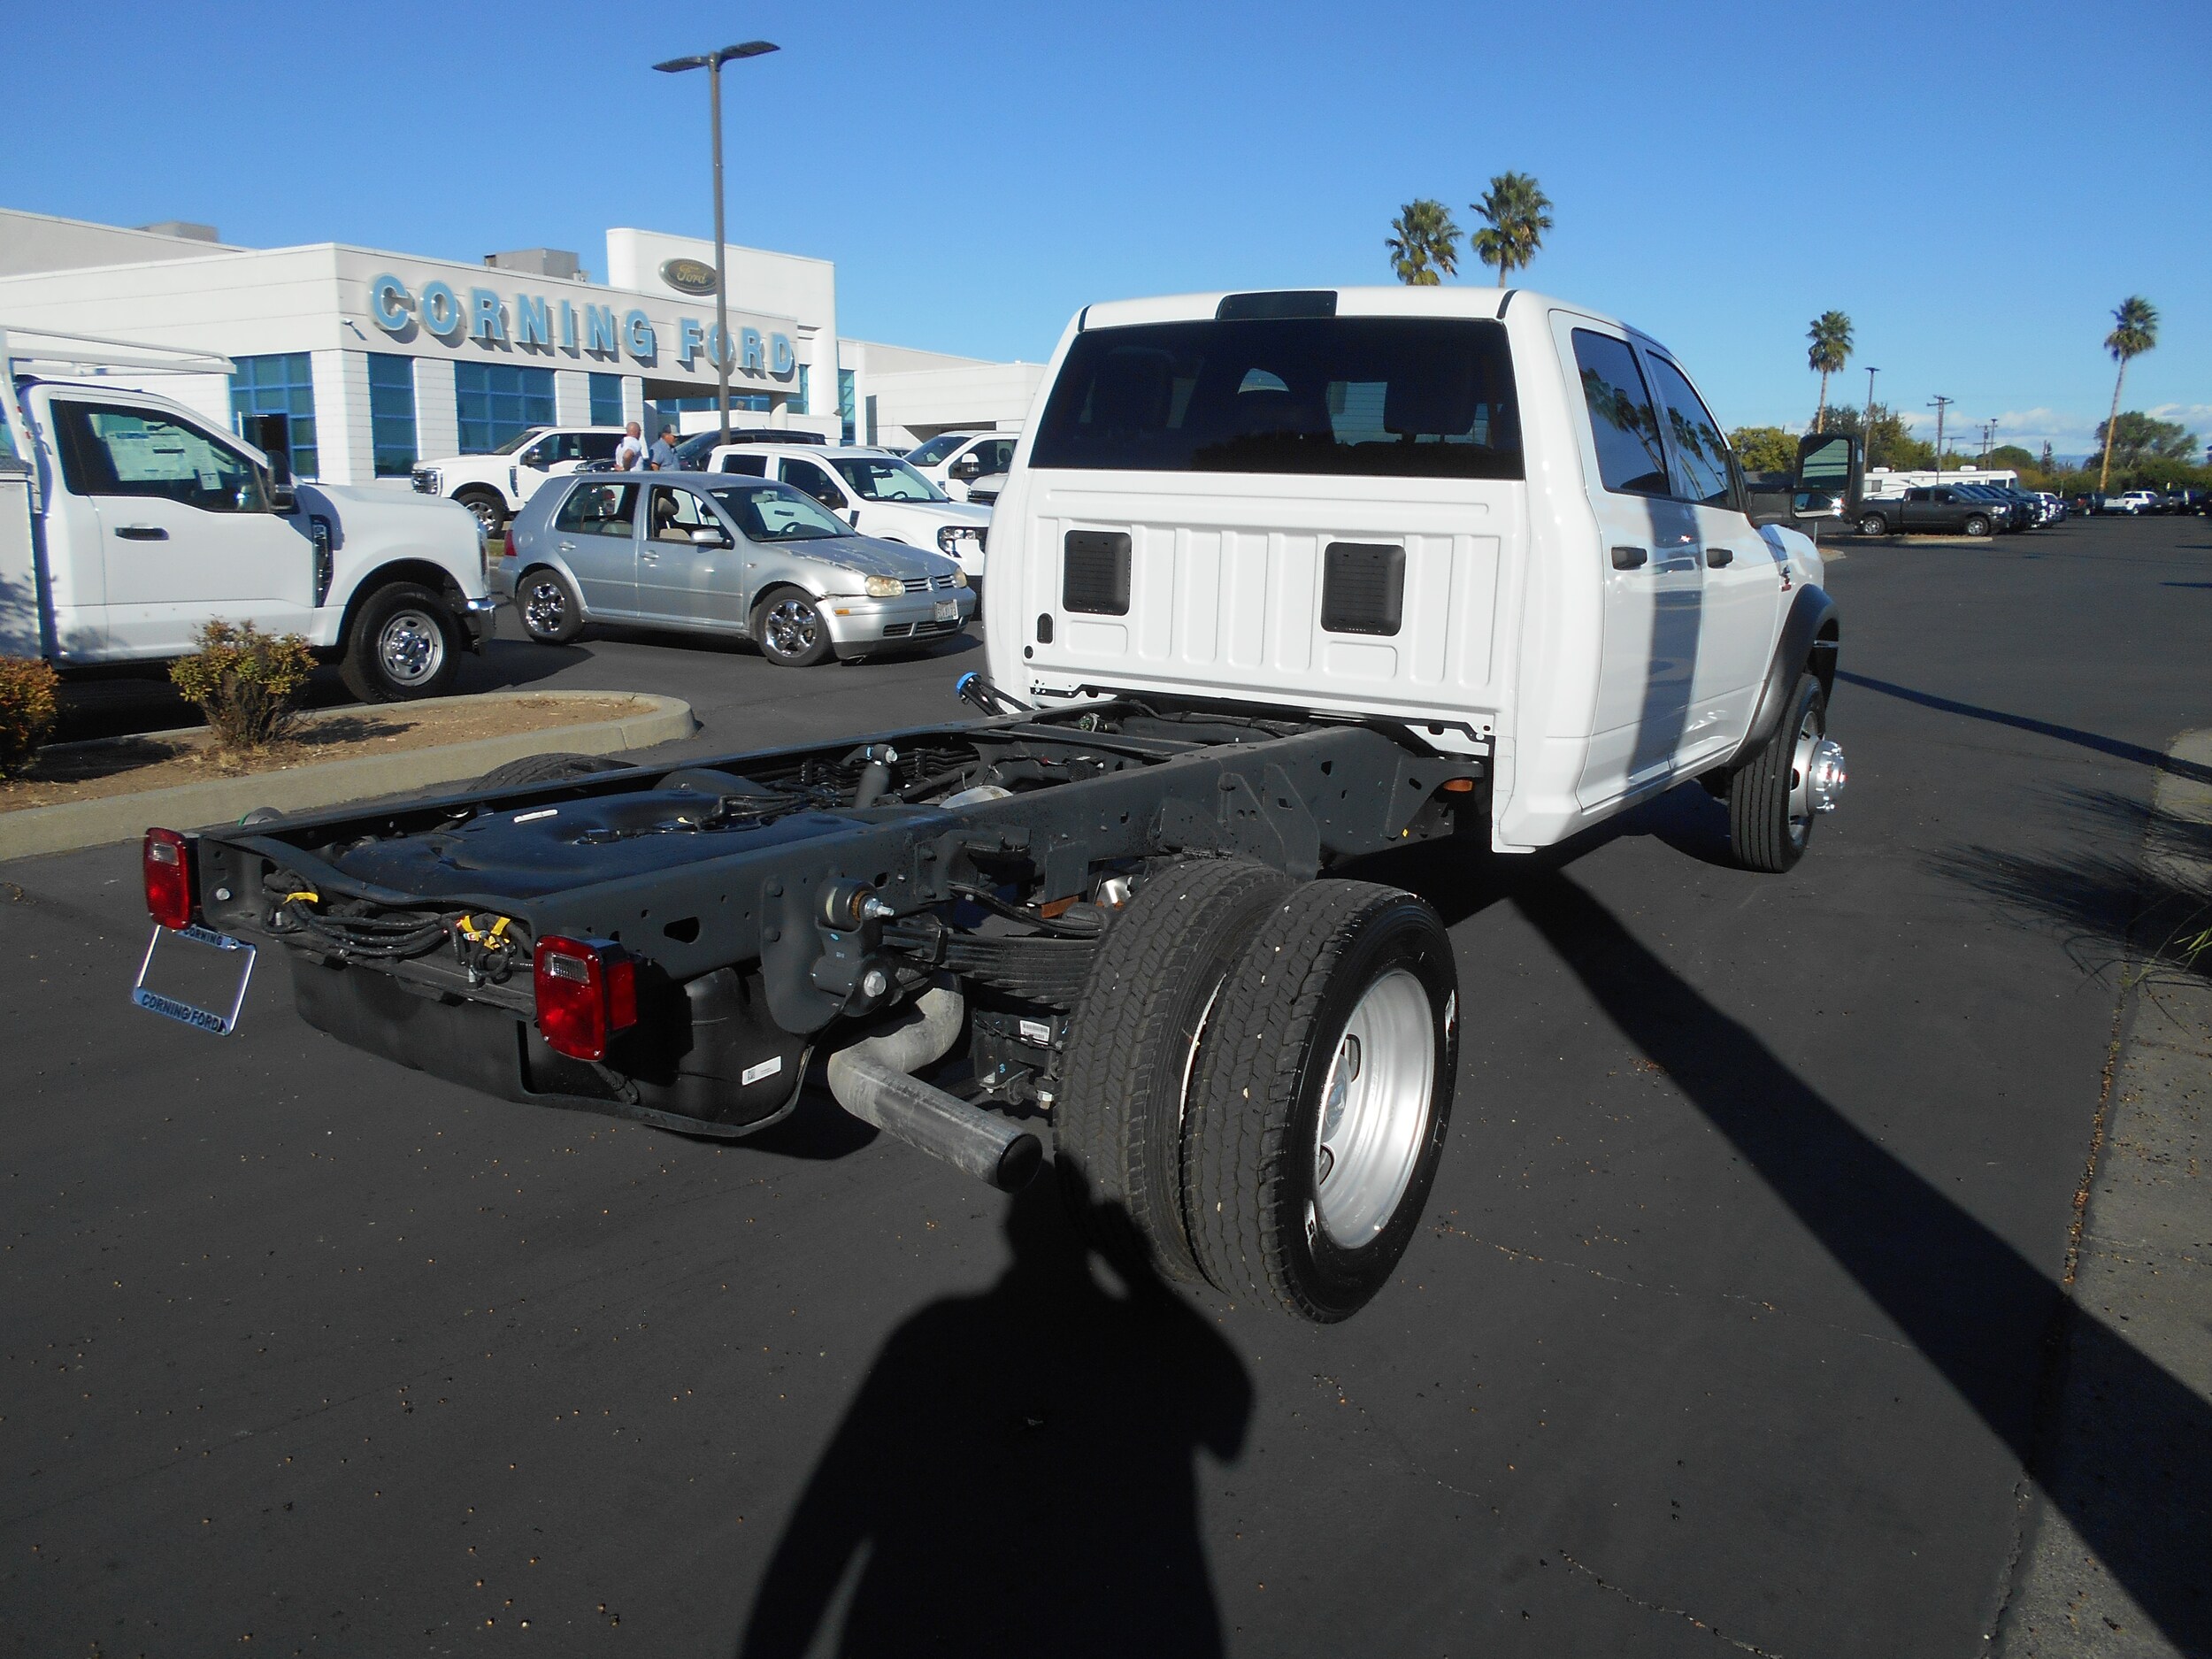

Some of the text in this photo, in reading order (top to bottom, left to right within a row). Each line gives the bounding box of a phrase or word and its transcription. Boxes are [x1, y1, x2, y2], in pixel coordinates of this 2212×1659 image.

[677, 264, 708, 284] Ford
[368, 273, 793, 373] CORNING FORD
[142, 993, 220, 1032] CORNING FORD
